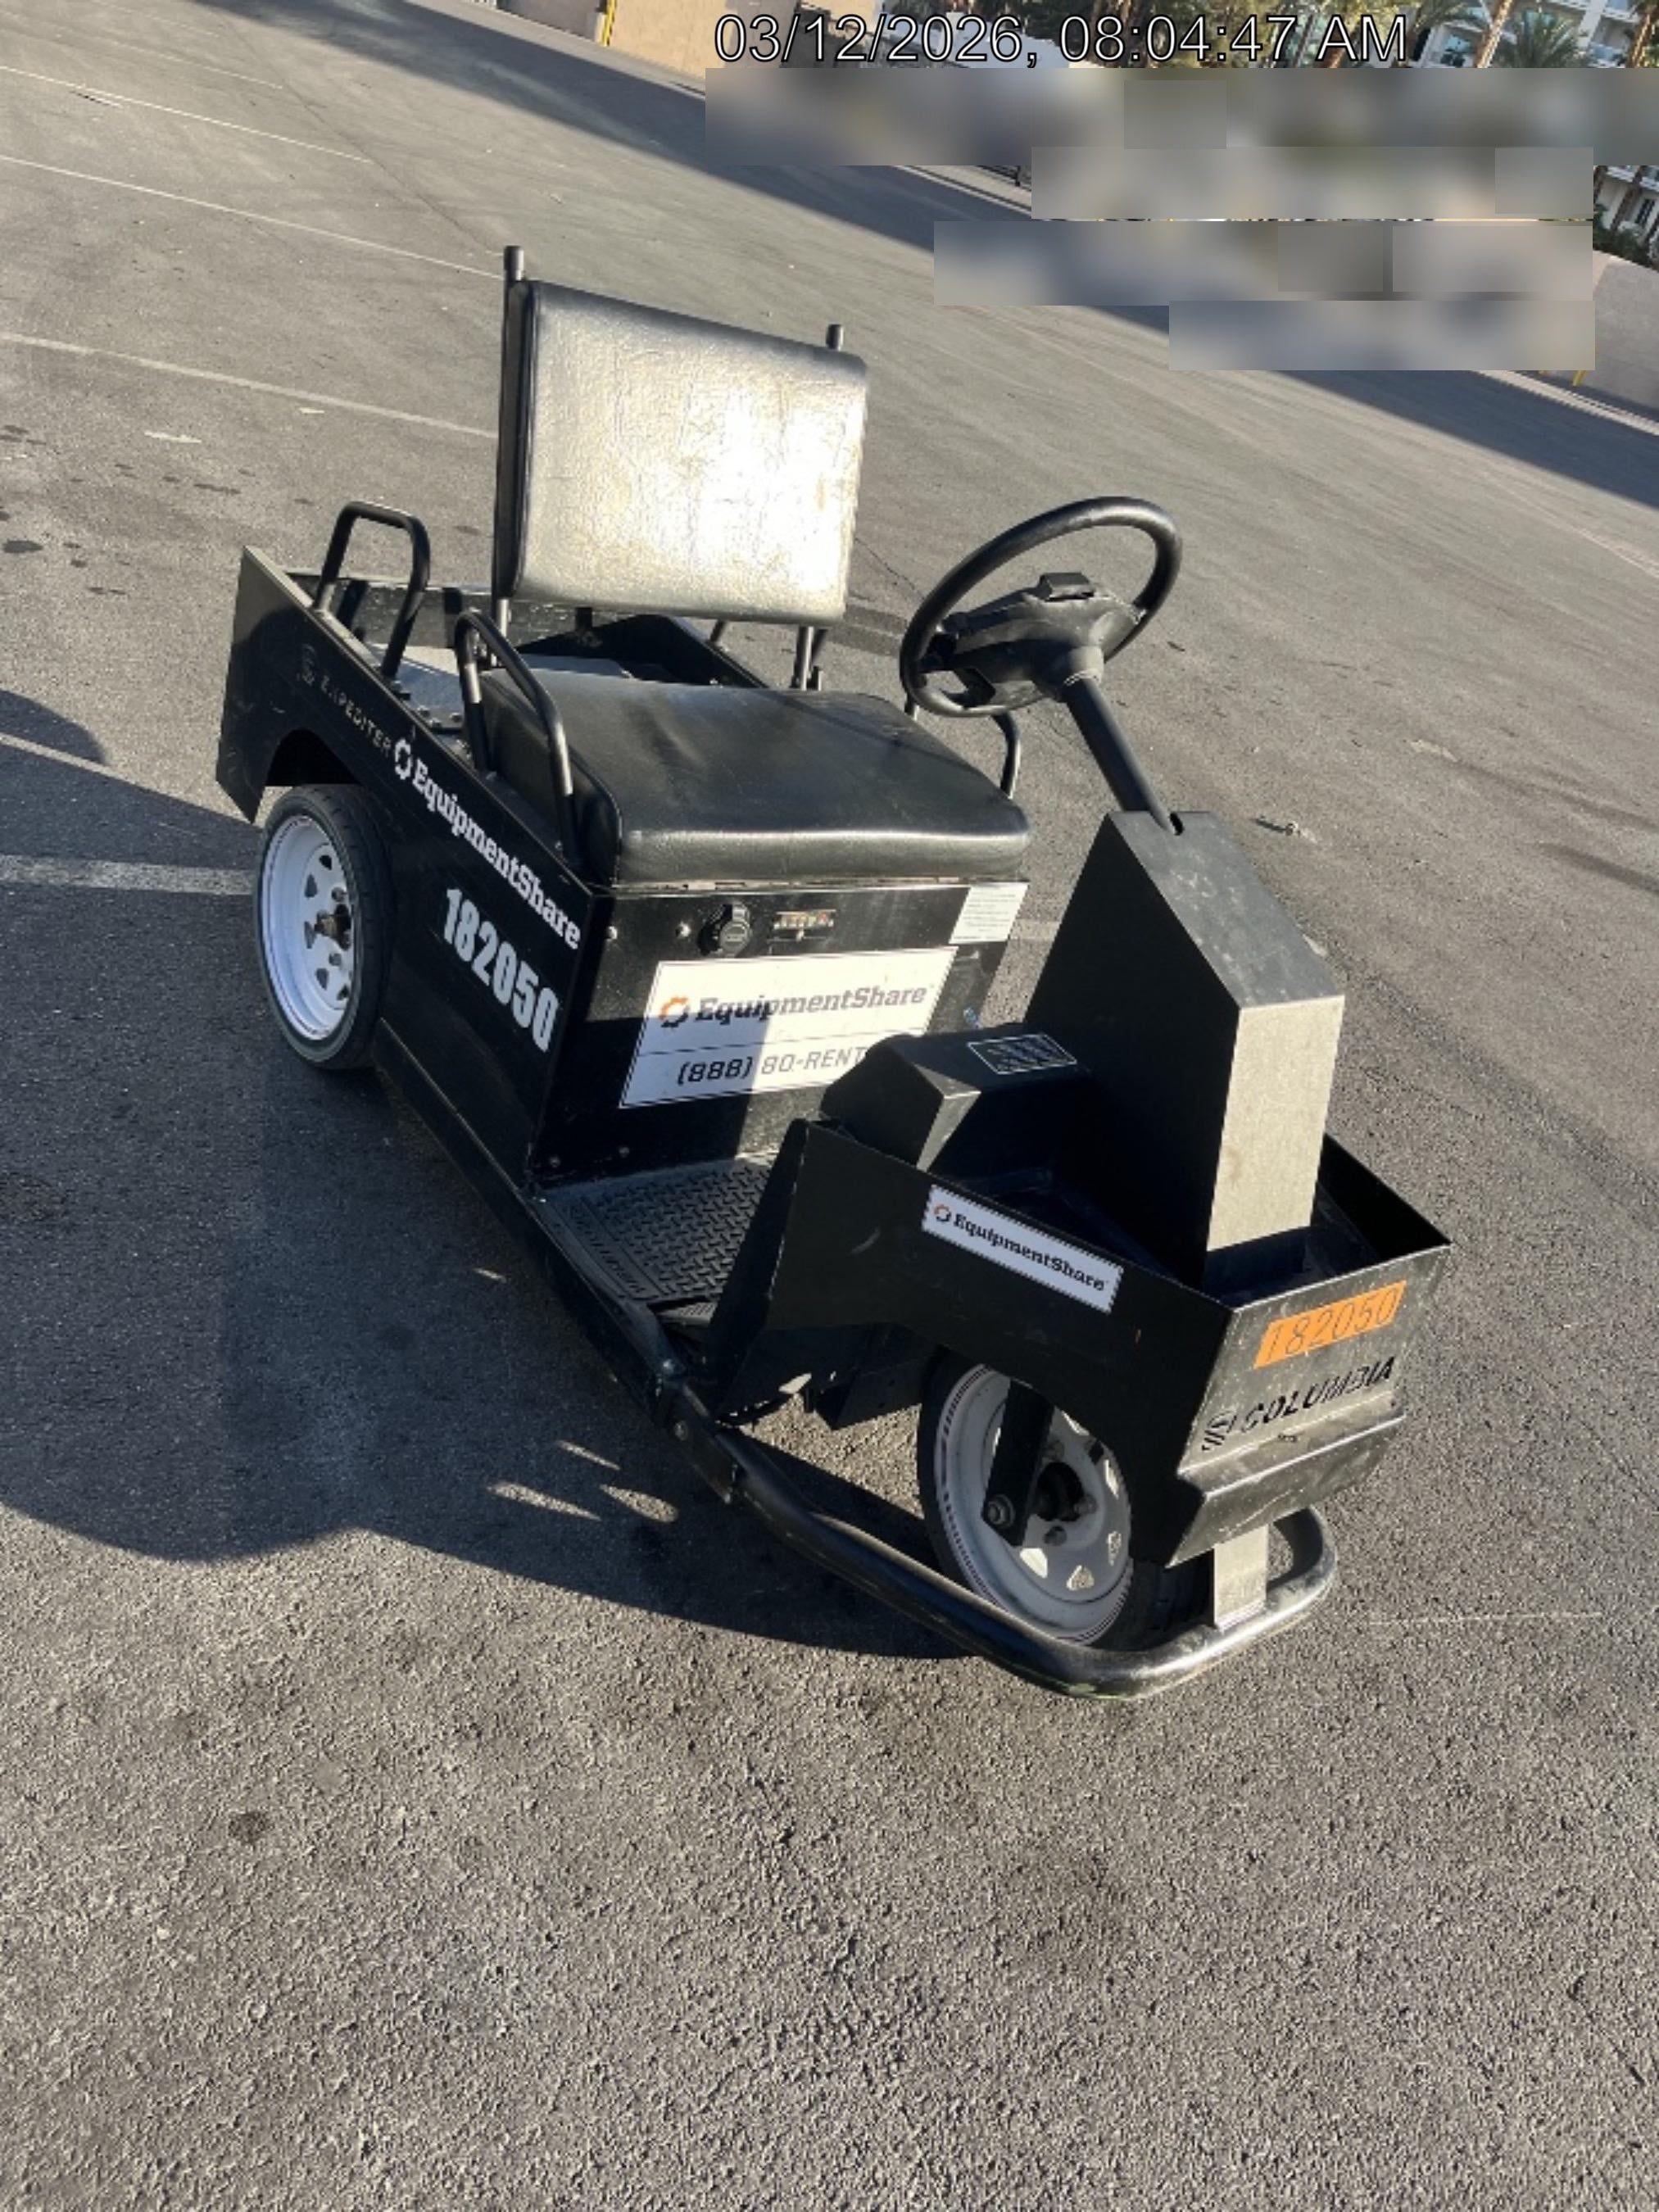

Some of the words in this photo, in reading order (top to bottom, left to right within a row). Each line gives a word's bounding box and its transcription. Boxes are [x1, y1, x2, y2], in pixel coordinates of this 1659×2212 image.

[411, 759, 582, 950] EquipmentShare
[444, 887, 560, 1053] 182050
[696, 986, 928, 1025] EquipmentShare
[677, 1056, 754, 1086] (888)
[953, 1213, 1106, 1292] EquipmentShare
[1267, 1287, 1401, 1362] 182050
[1240, 1355, 1395, 1434] COLUMBIA
